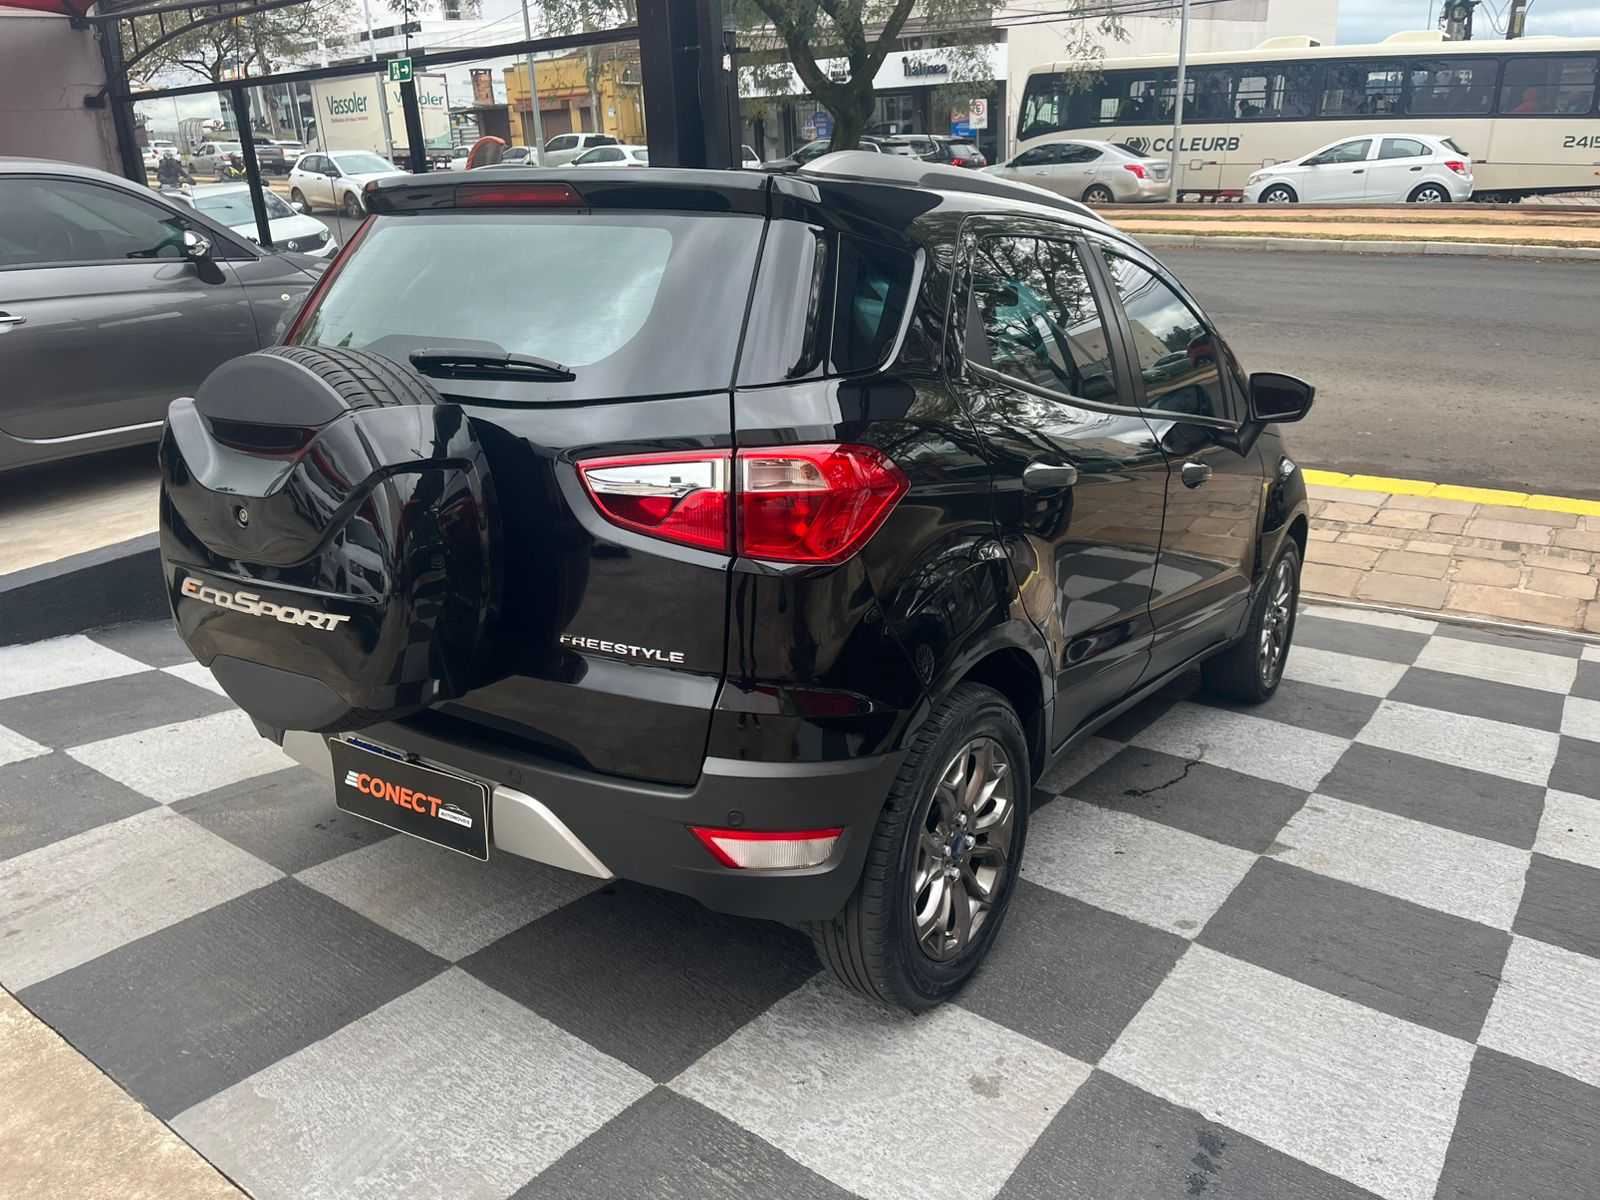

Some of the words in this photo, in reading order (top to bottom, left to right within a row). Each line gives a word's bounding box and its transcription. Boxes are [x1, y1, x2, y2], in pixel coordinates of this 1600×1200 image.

[326, 91, 368, 115] Vassoler
[559, 633, 685, 664] FREESTYLE
[356, 772, 443, 818] CONECT
